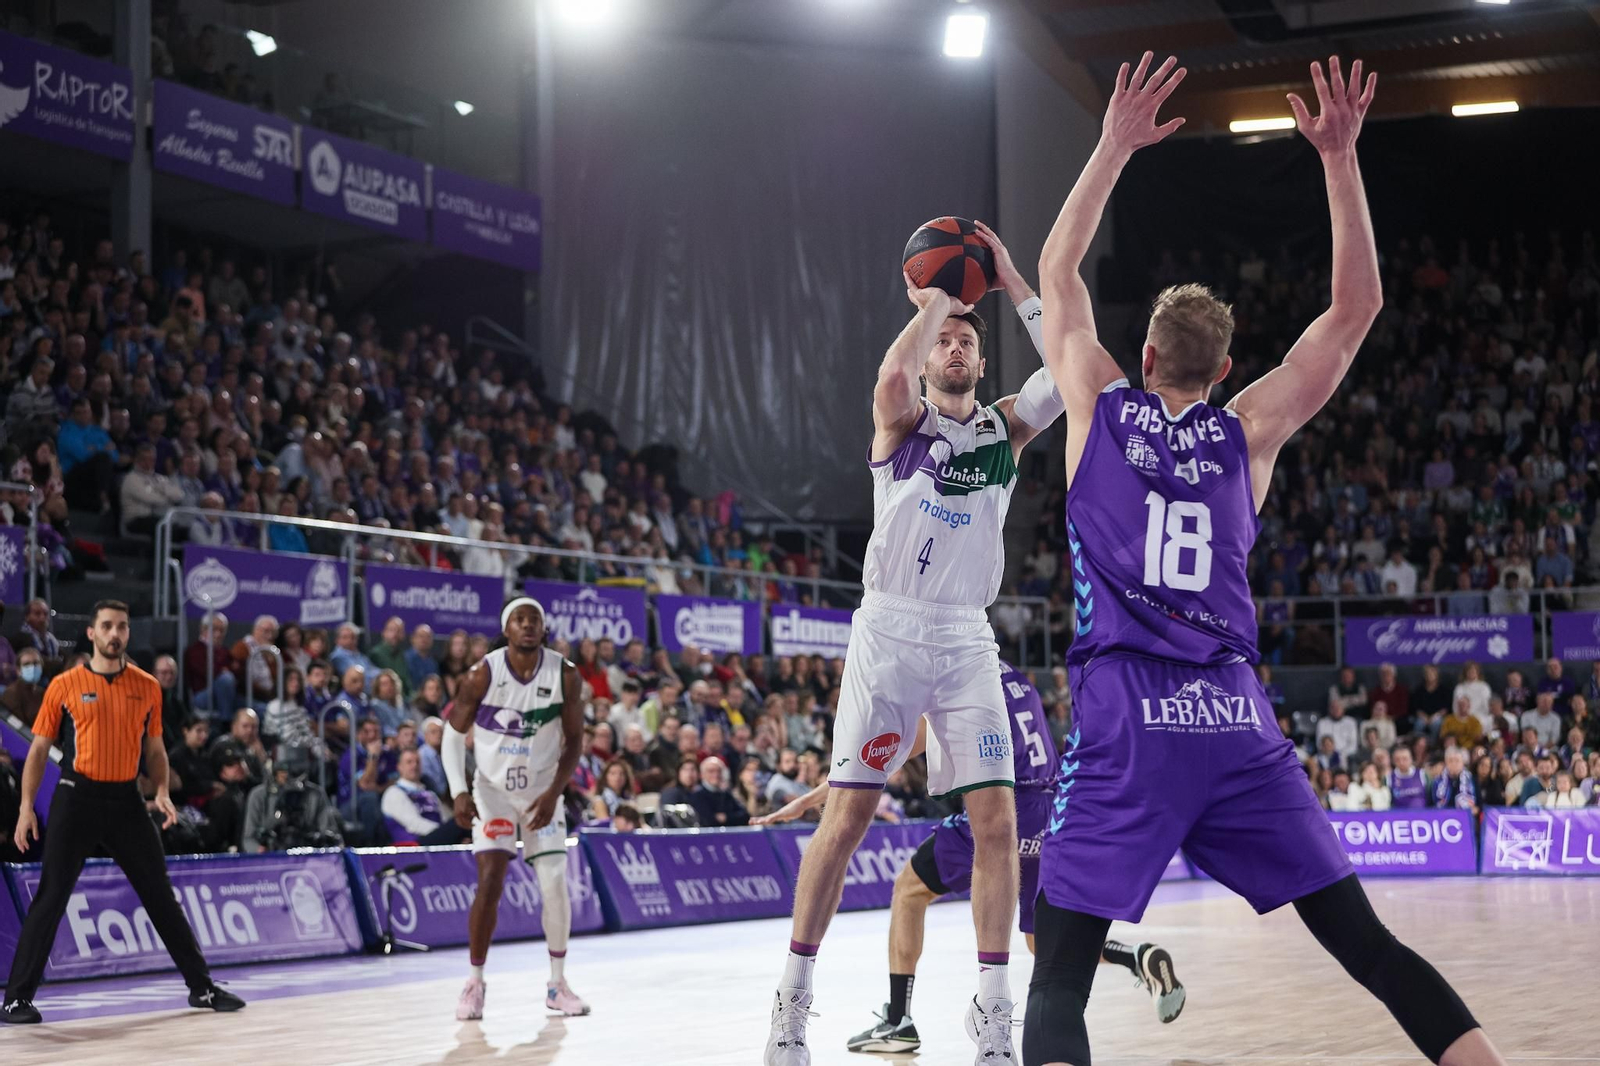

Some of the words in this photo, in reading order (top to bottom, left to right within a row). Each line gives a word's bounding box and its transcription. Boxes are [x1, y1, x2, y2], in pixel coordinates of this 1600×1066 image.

[36, 60, 133, 120] RAPTOR
[344, 160, 421, 207] AUPASA
[917, 537, 934, 575] 4
[1144, 490, 1213, 592] 18
[545, 612, 632, 646] MUNDO
[1413, 616, 1508, 633] AMBULANCIAS
[1142, 697, 1261, 726] LEBANZA
[1014, 710, 1048, 767] 5
[1167, 725, 1186, 733] AGUA
[1188, 726, 1218, 734] MINERAL
[1220, 724, 1251, 732] NATURAL
[979, 743, 1010, 761] laga
[505, 766, 528, 792] 55
[670, 844, 754, 865] HOTEL
[675, 878, 713, 906] REY
[712, 875, 782, 903] SANCHO
